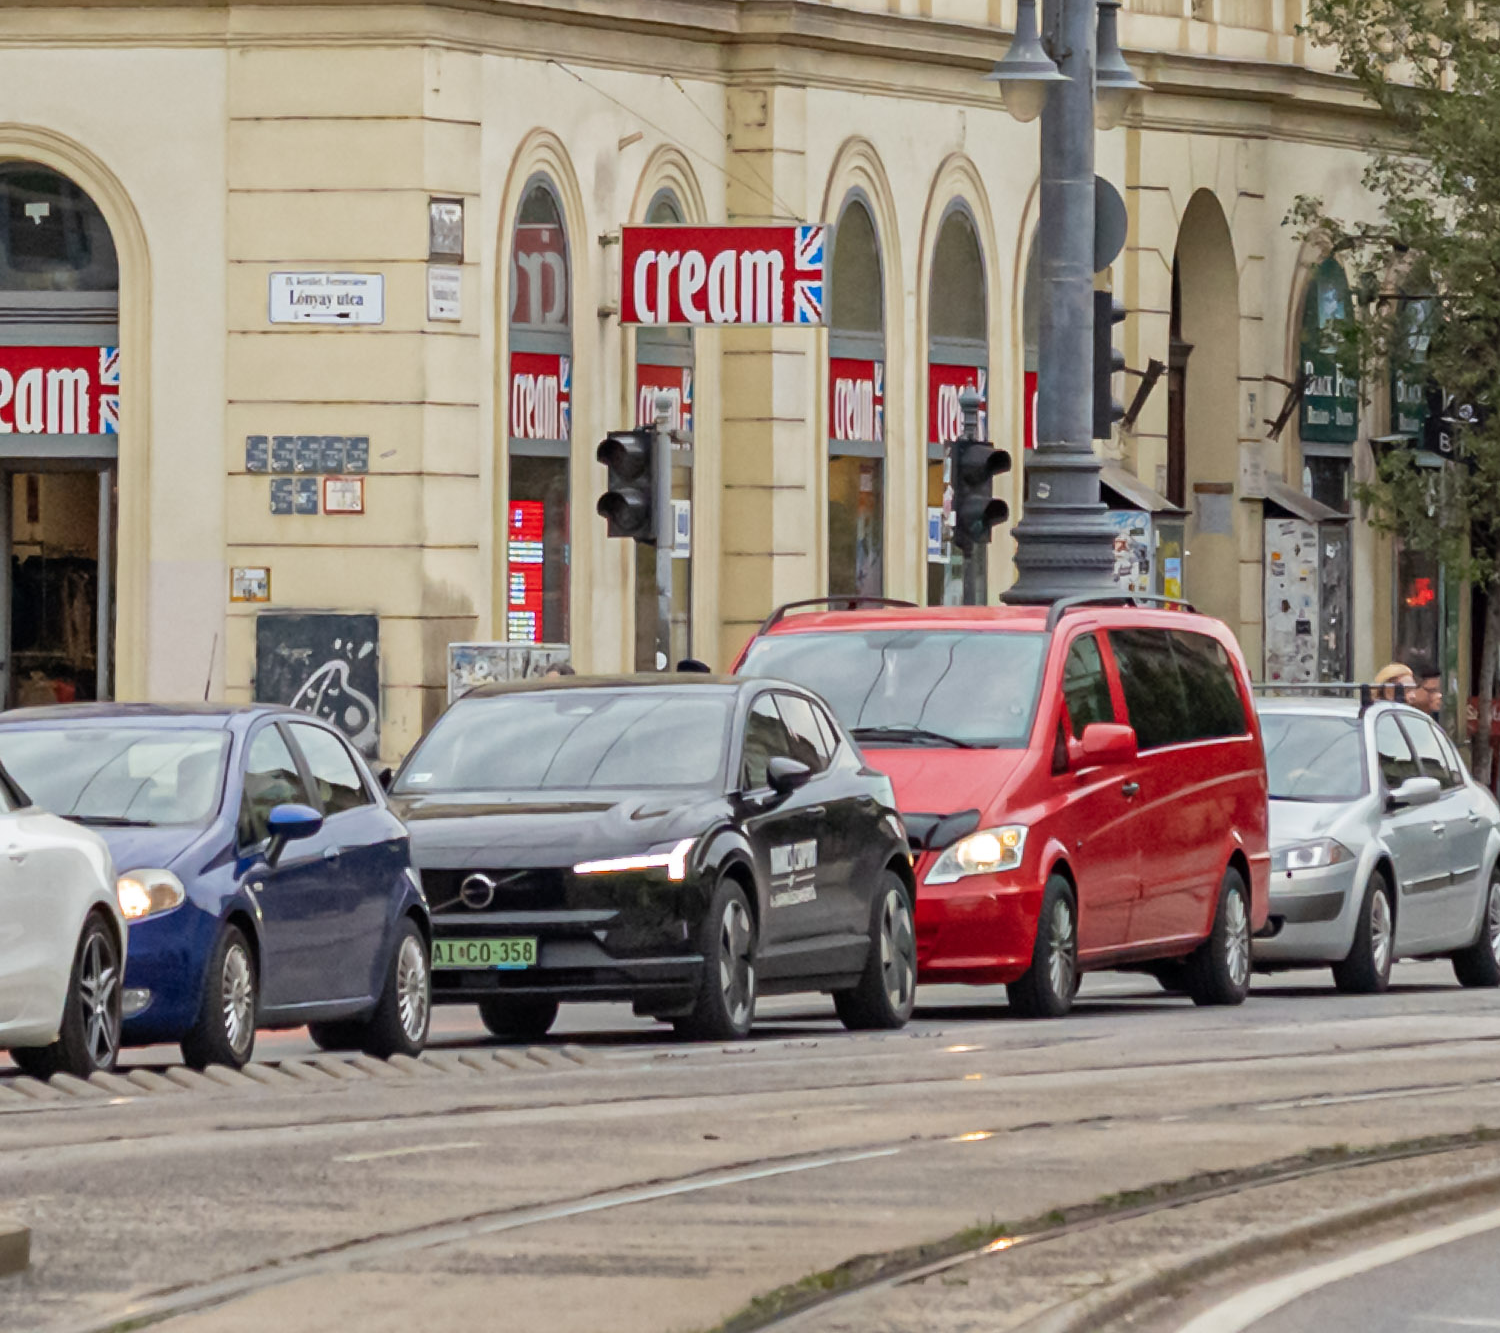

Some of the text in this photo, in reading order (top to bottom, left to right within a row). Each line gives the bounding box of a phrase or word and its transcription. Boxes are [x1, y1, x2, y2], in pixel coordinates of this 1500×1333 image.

[289, 290, 364, 309] Lónyay utca
[633, 250, 784, 323] cream
[512, 373, 559, 439] cream
[834, 378, 874, 440] cream
